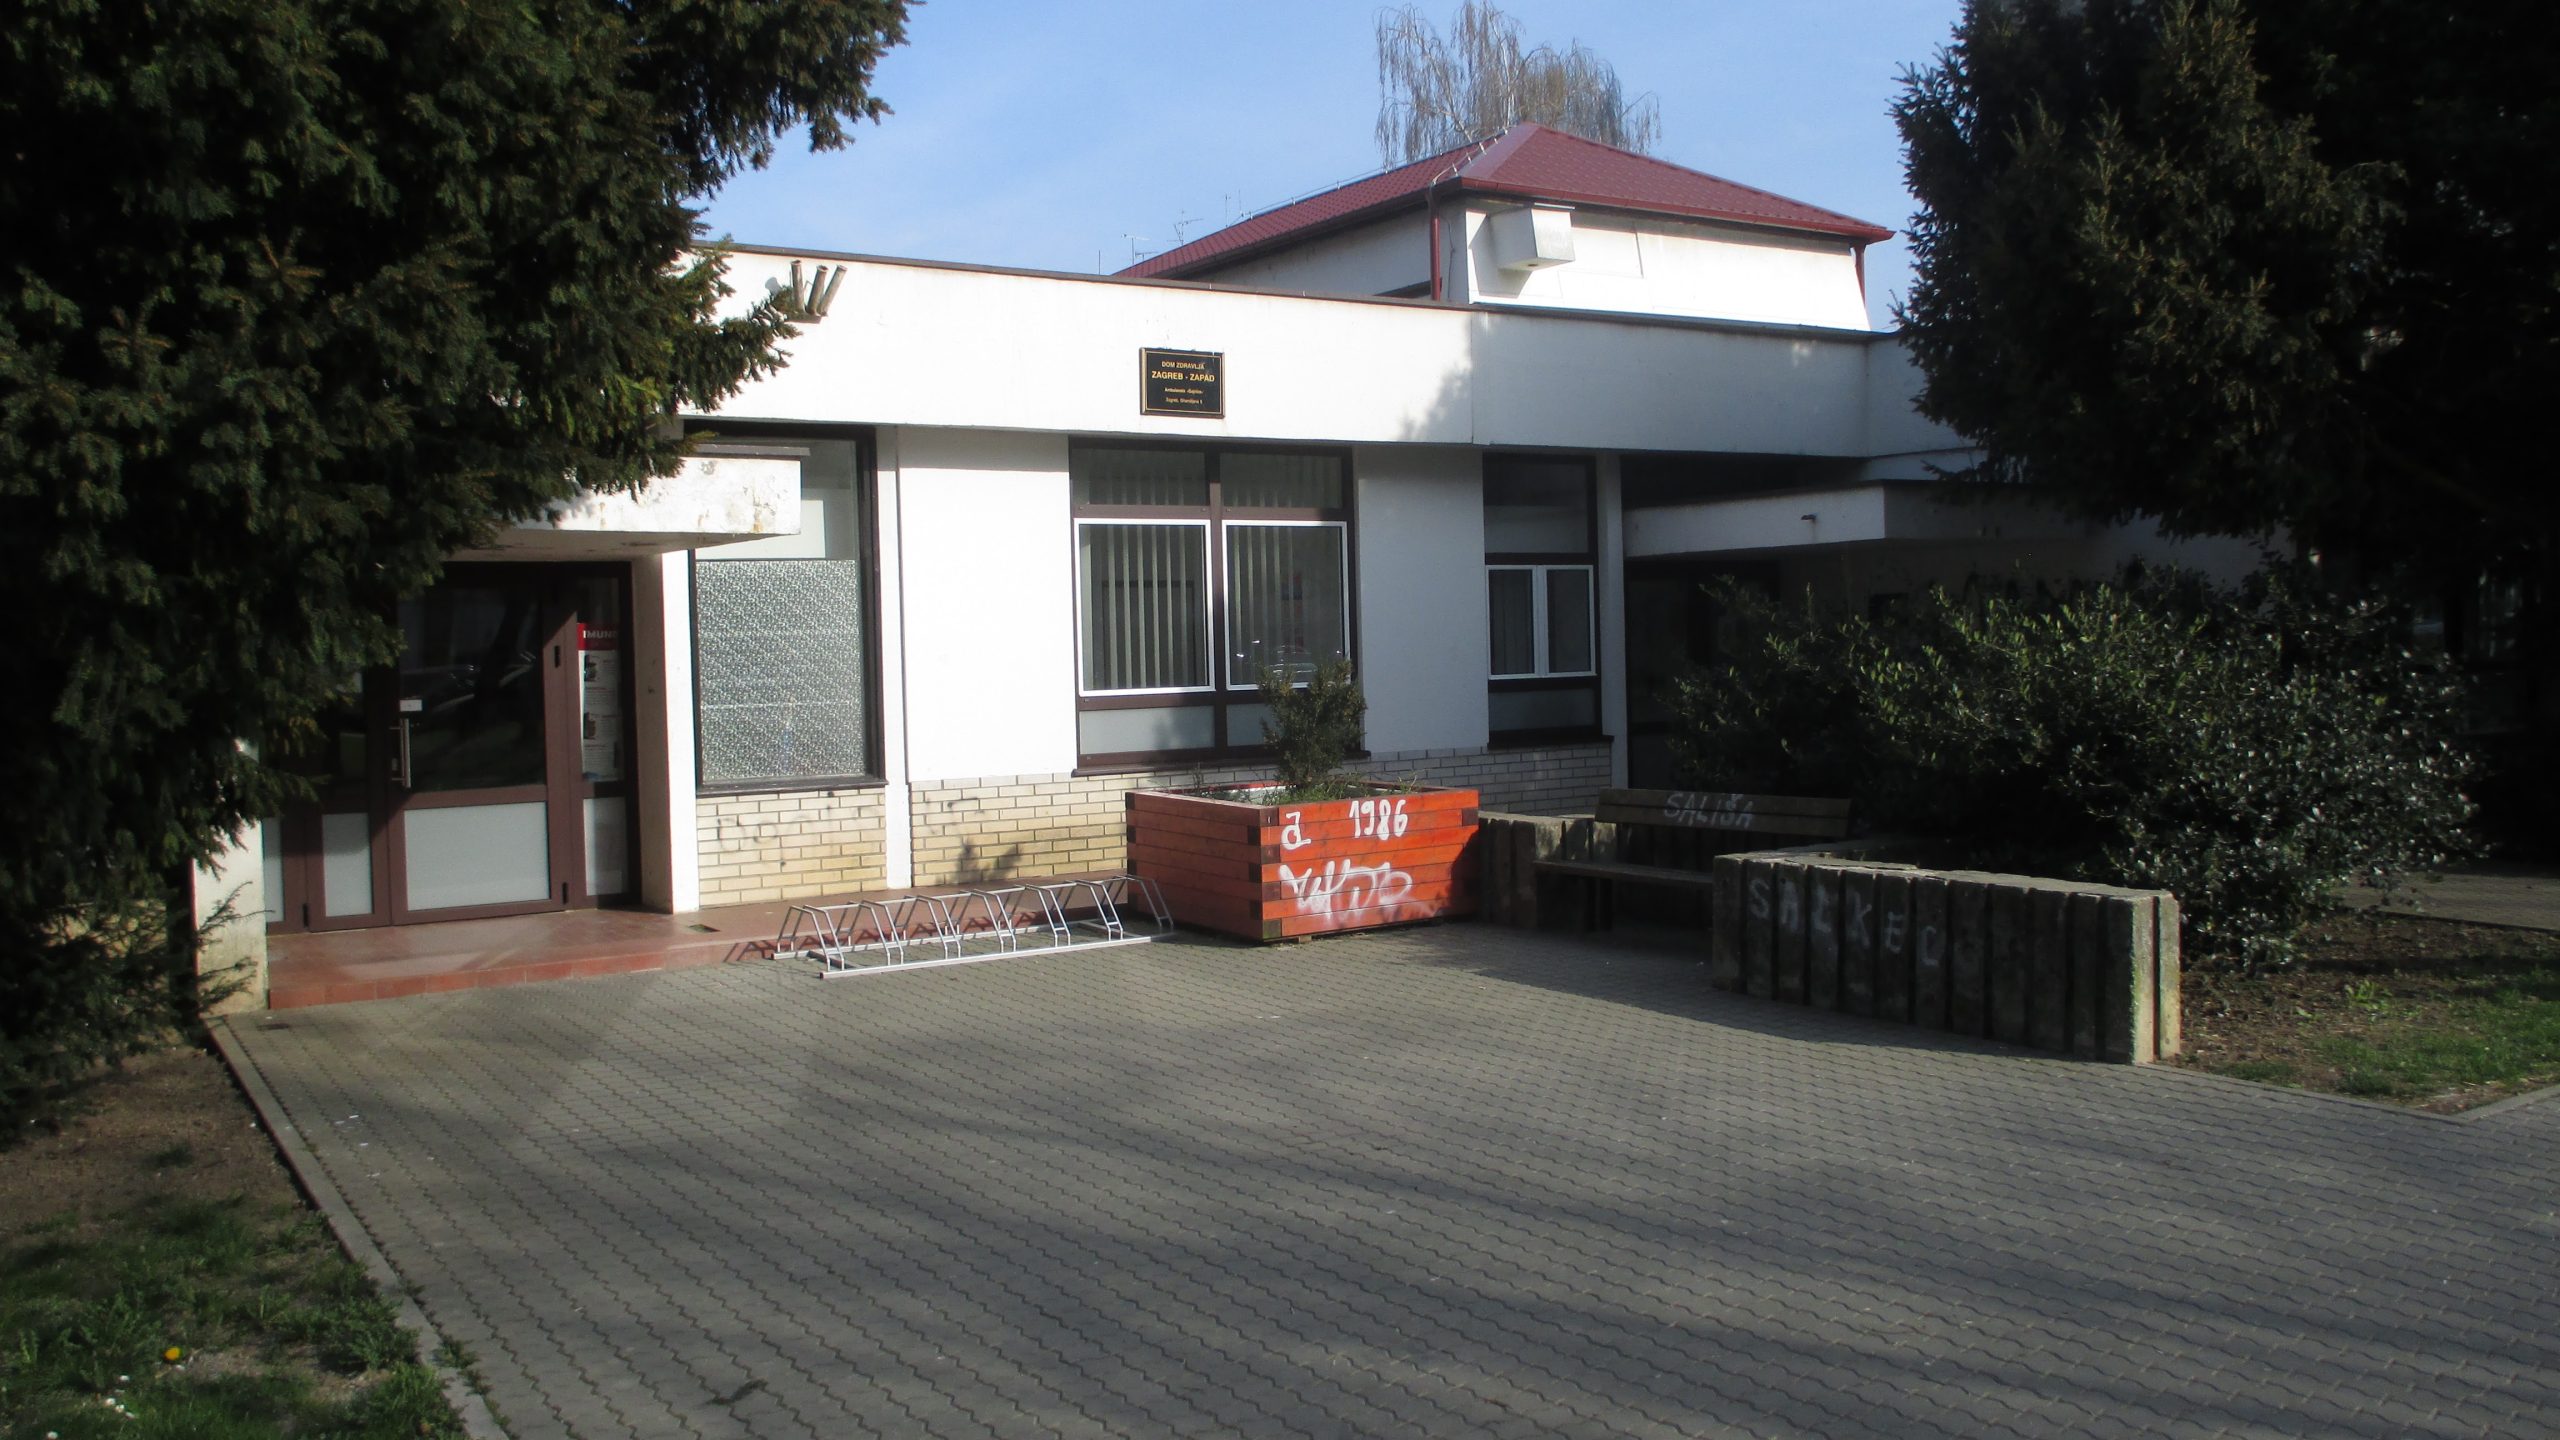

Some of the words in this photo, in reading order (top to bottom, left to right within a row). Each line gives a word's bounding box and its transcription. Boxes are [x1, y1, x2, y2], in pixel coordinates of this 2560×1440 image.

[1176, 362, 1205, 370] ZDRAVLJA
[1151, 370, 1183, 380] ZAGREB
[1189, 373, 1215, 382] ZAPAD
[1349, 799, 1408, 840] 1986
